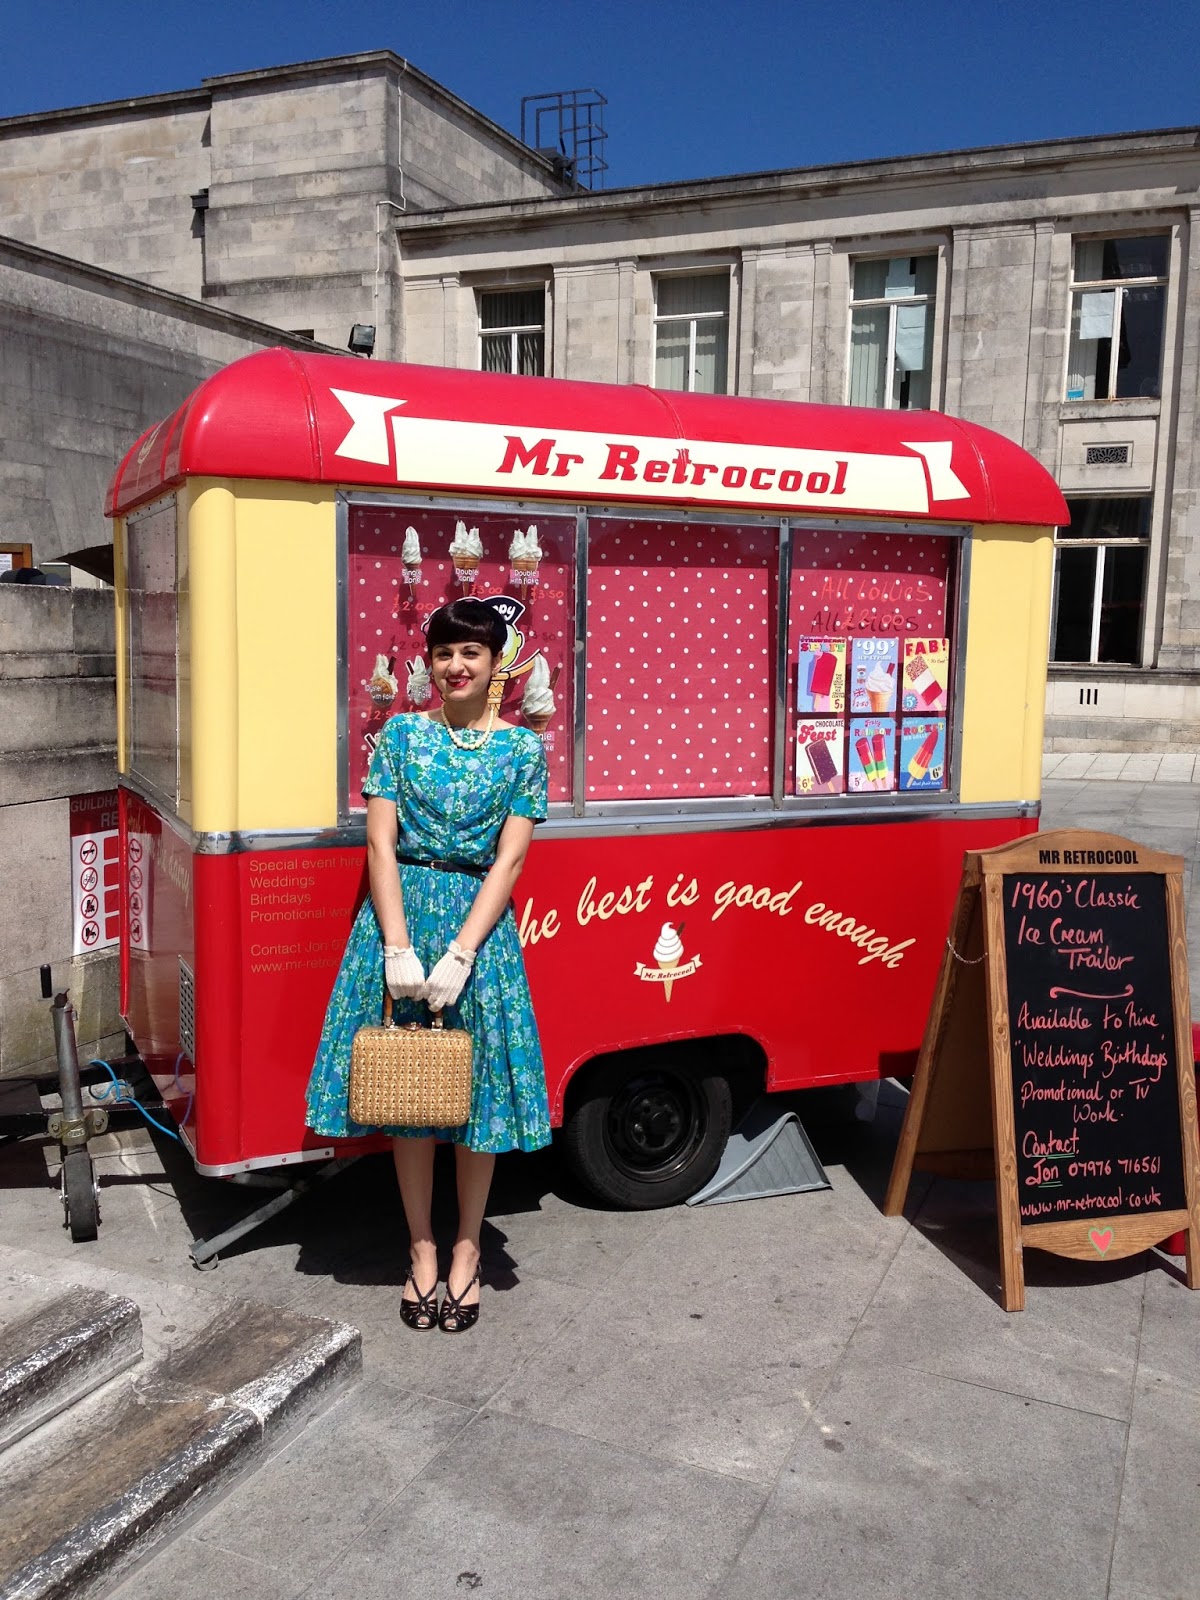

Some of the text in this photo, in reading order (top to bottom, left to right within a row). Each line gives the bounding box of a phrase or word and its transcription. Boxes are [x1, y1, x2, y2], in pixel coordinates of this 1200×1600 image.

[495, 435, 849, 495] Mr Retrocool
[455, 568, 479, 576] Double
[514, 569, 537, 577] Double
[821, 577, 849, 601] All
[800, 643, 845, 652] SPLIT
[815, 720, 844, 728] CHOCOLATE
[854, 727, 892, 737] RAINBOW
[798, 724, 837, 745] Feast
[250, 856, 363, 874] Special event hire
[1039, 850, 1139, 865] MR RETROCOOL
[250, 876, 315, 889] Weddings
[250, 893, 311, 905] Birthdays
[1075, 879, 1141, 909] Classic
[251, 907, 325, 922] Promotional
[576, 875, 653, 926] best
[667, 873, 700, 907] is
[711, 880, 803, 922] good
[804, 902, 916, 969] enough
[1018, 915, 1104, 945] Ice Cream
[251, 943, 301, 956] Contact
[305, 941, 328, 953] Jon
[1058, 946, 1135, 970] Trailer
[1018, 1001, 1092, 1029] Available
[1103, 1003, 1122, 1029] to
[1021, 1077, 1151, 1109] Promotional or TV
[1025, 1156, 1161, 1186] Jon 07976 716561
